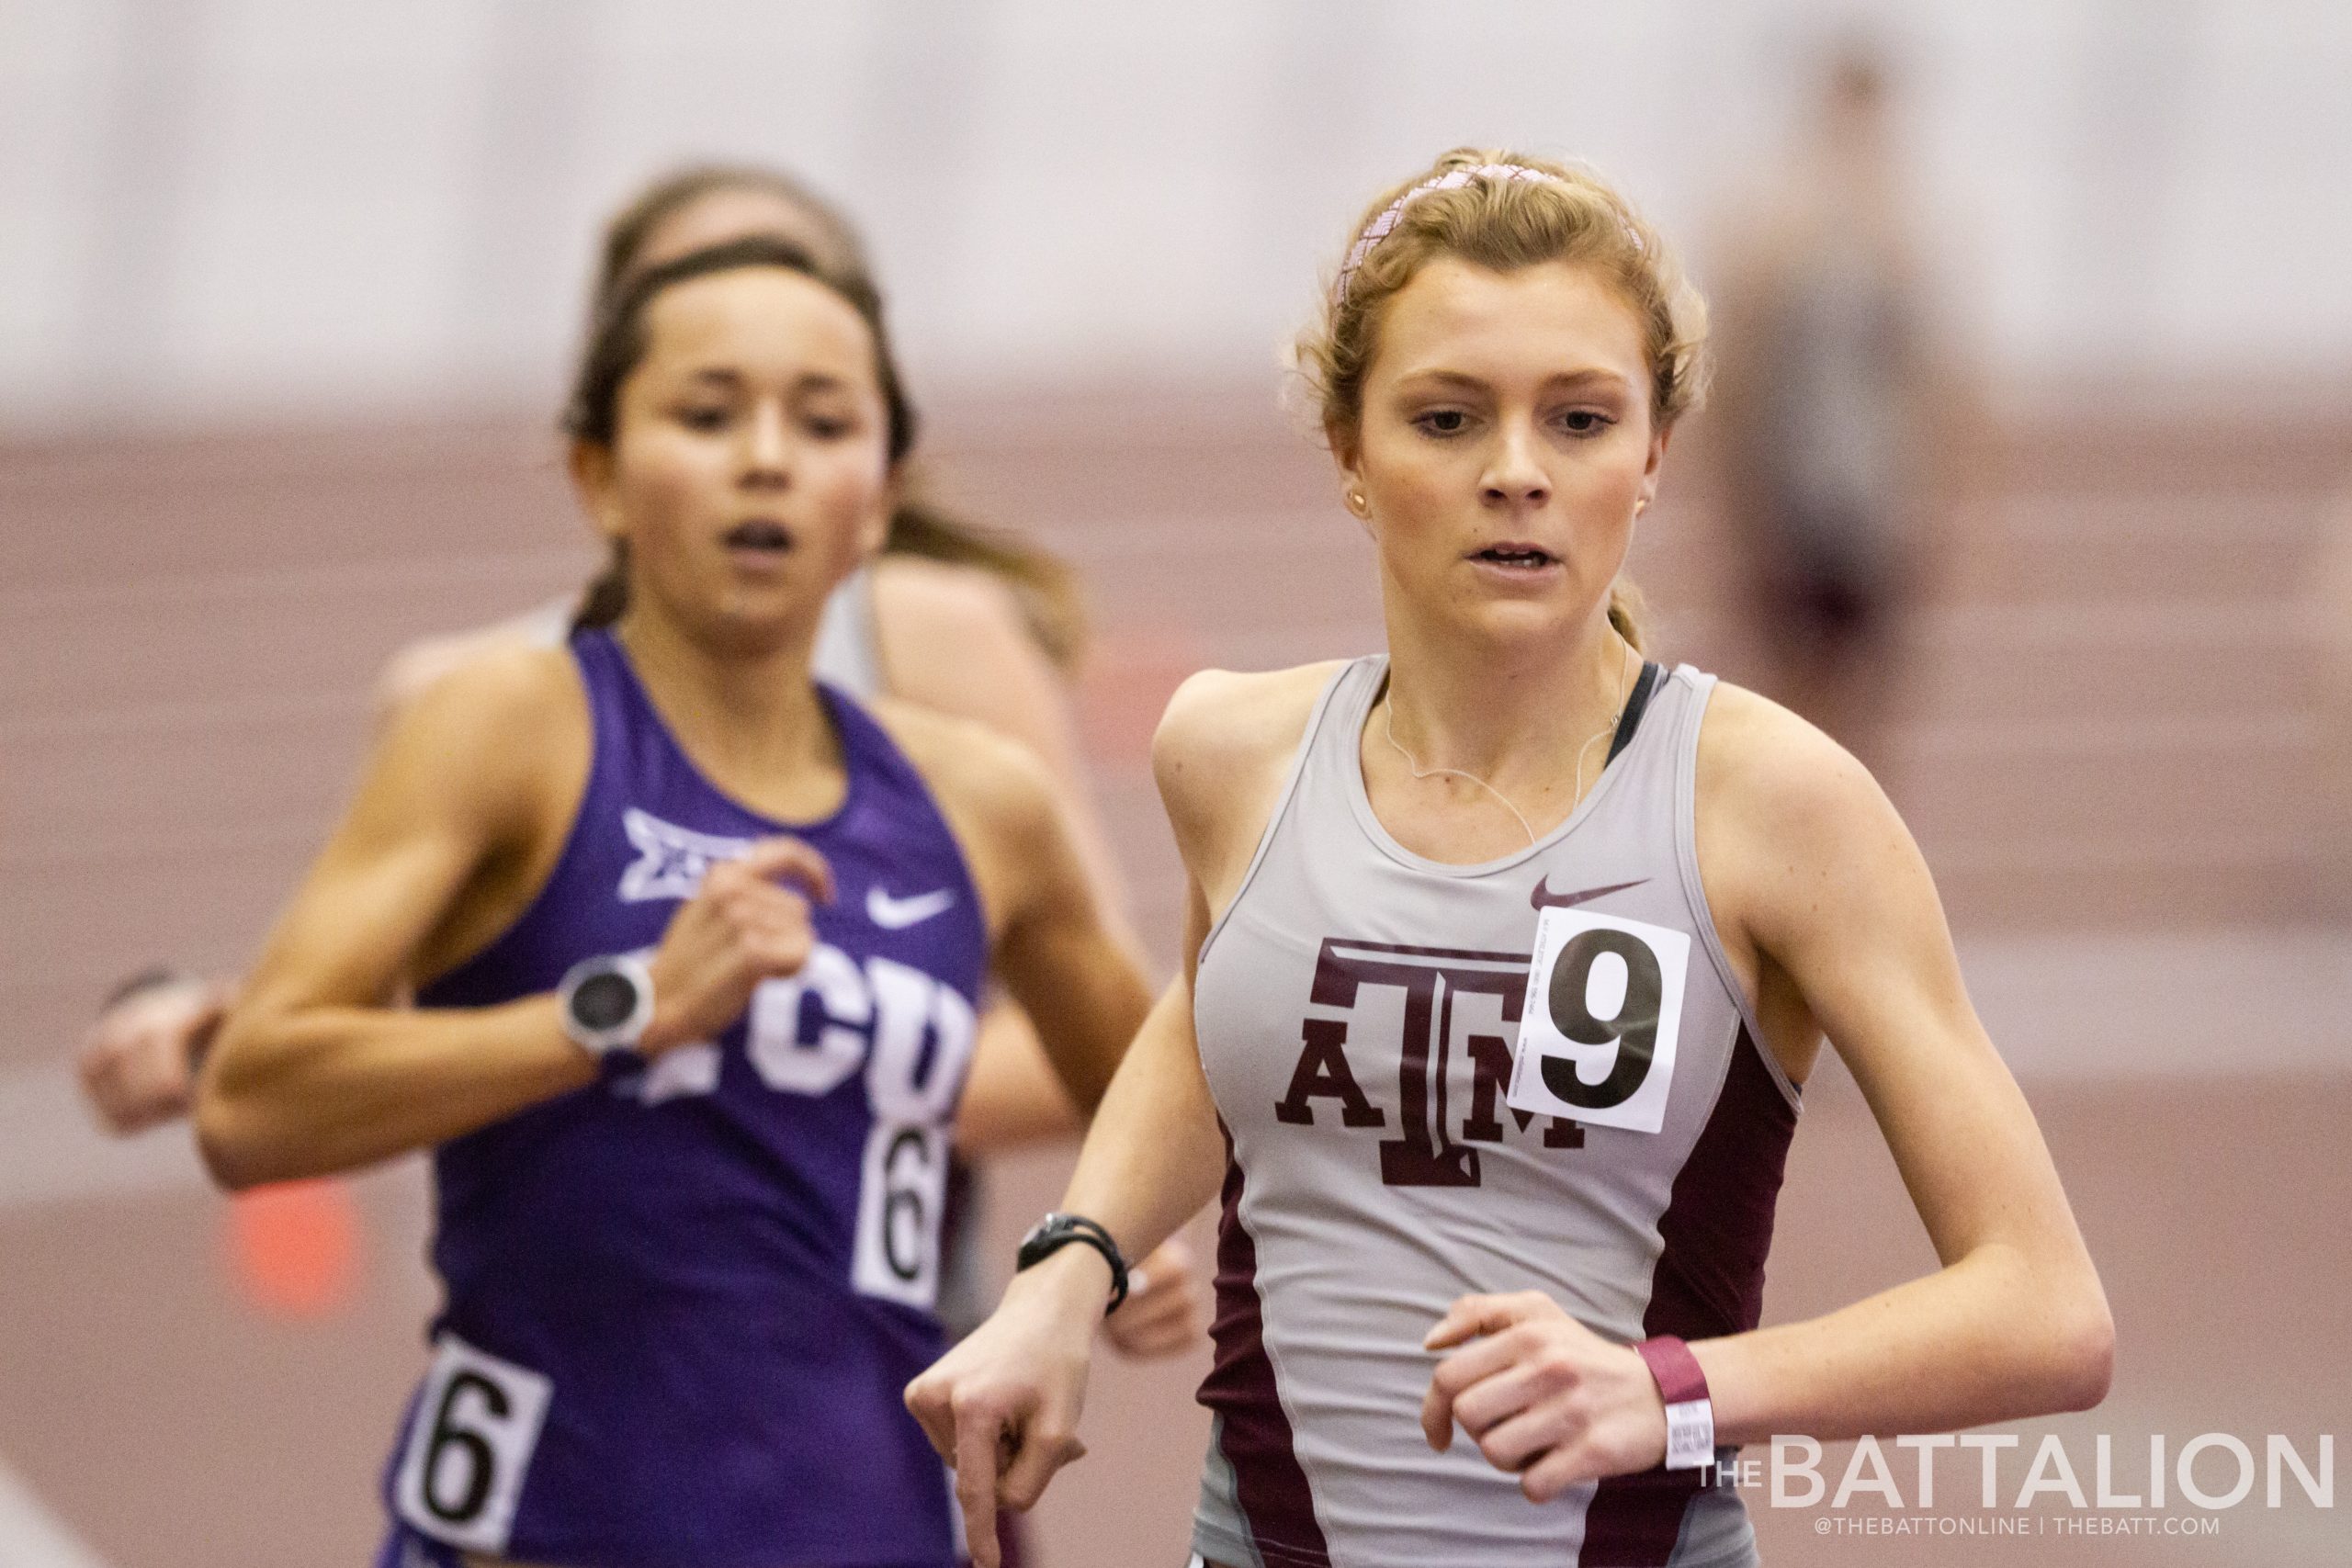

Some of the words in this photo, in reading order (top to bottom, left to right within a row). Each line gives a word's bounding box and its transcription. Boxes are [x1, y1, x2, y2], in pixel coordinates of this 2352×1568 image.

[614, 944, 977, 1122] CU
[1541, 928, 1662, 1110] 9
[883, 1128, 929, 1280] 6
[424, 1371, 511, 1524] 6
